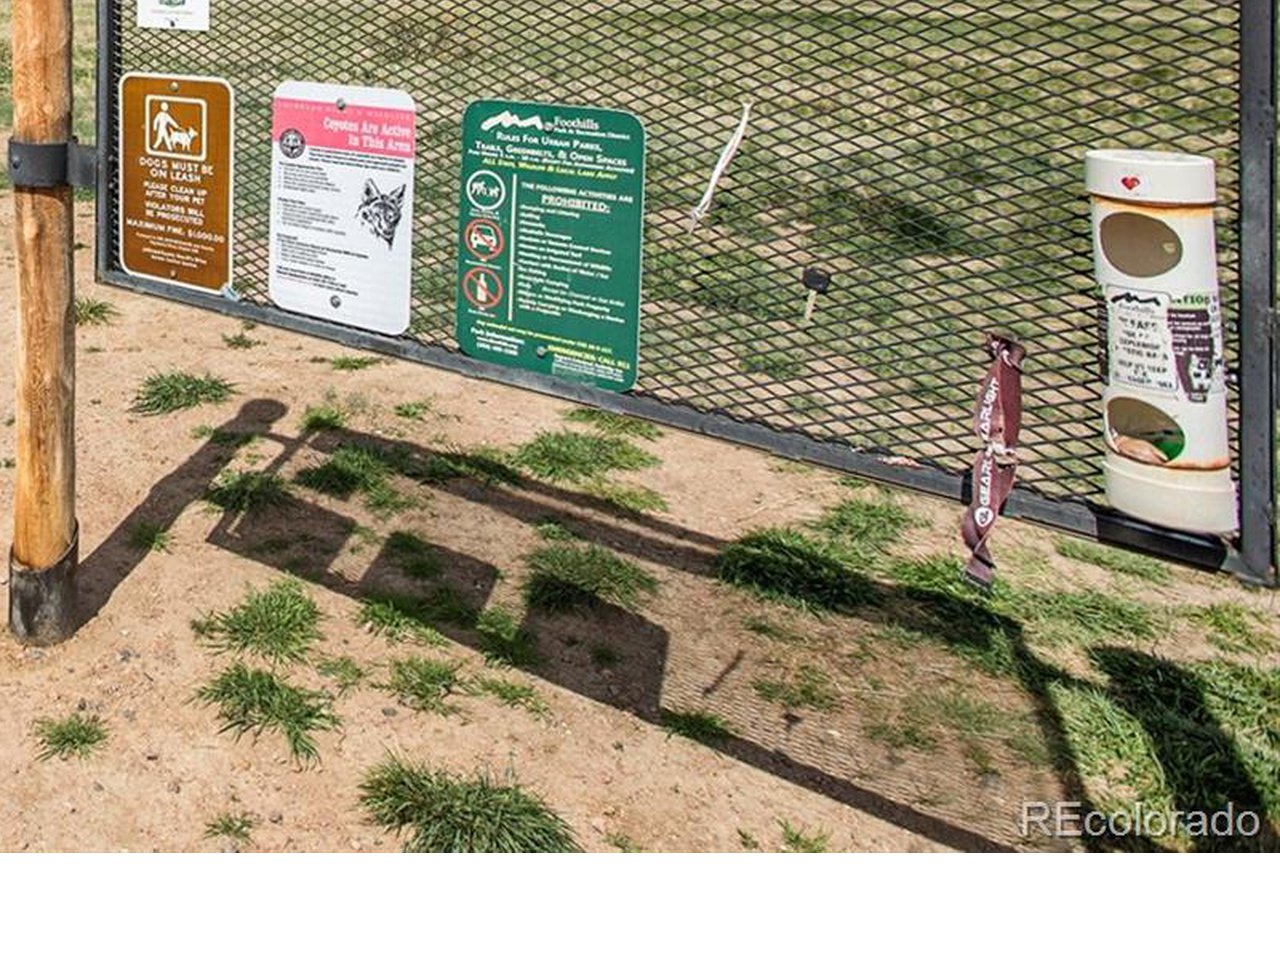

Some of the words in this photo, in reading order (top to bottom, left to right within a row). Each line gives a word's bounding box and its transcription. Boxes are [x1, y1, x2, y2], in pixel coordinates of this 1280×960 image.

[323, 117, 359, 133] Coyotes
[554, 116, 599, 130] Foothills
[139, 156, 169, 169] DOGS
[172, 161, 199, 172] MUST
[201, 165, 214, 175] BE
[150, 168, 167, 178] ON
[170, 171, 201, 184] LEASH
